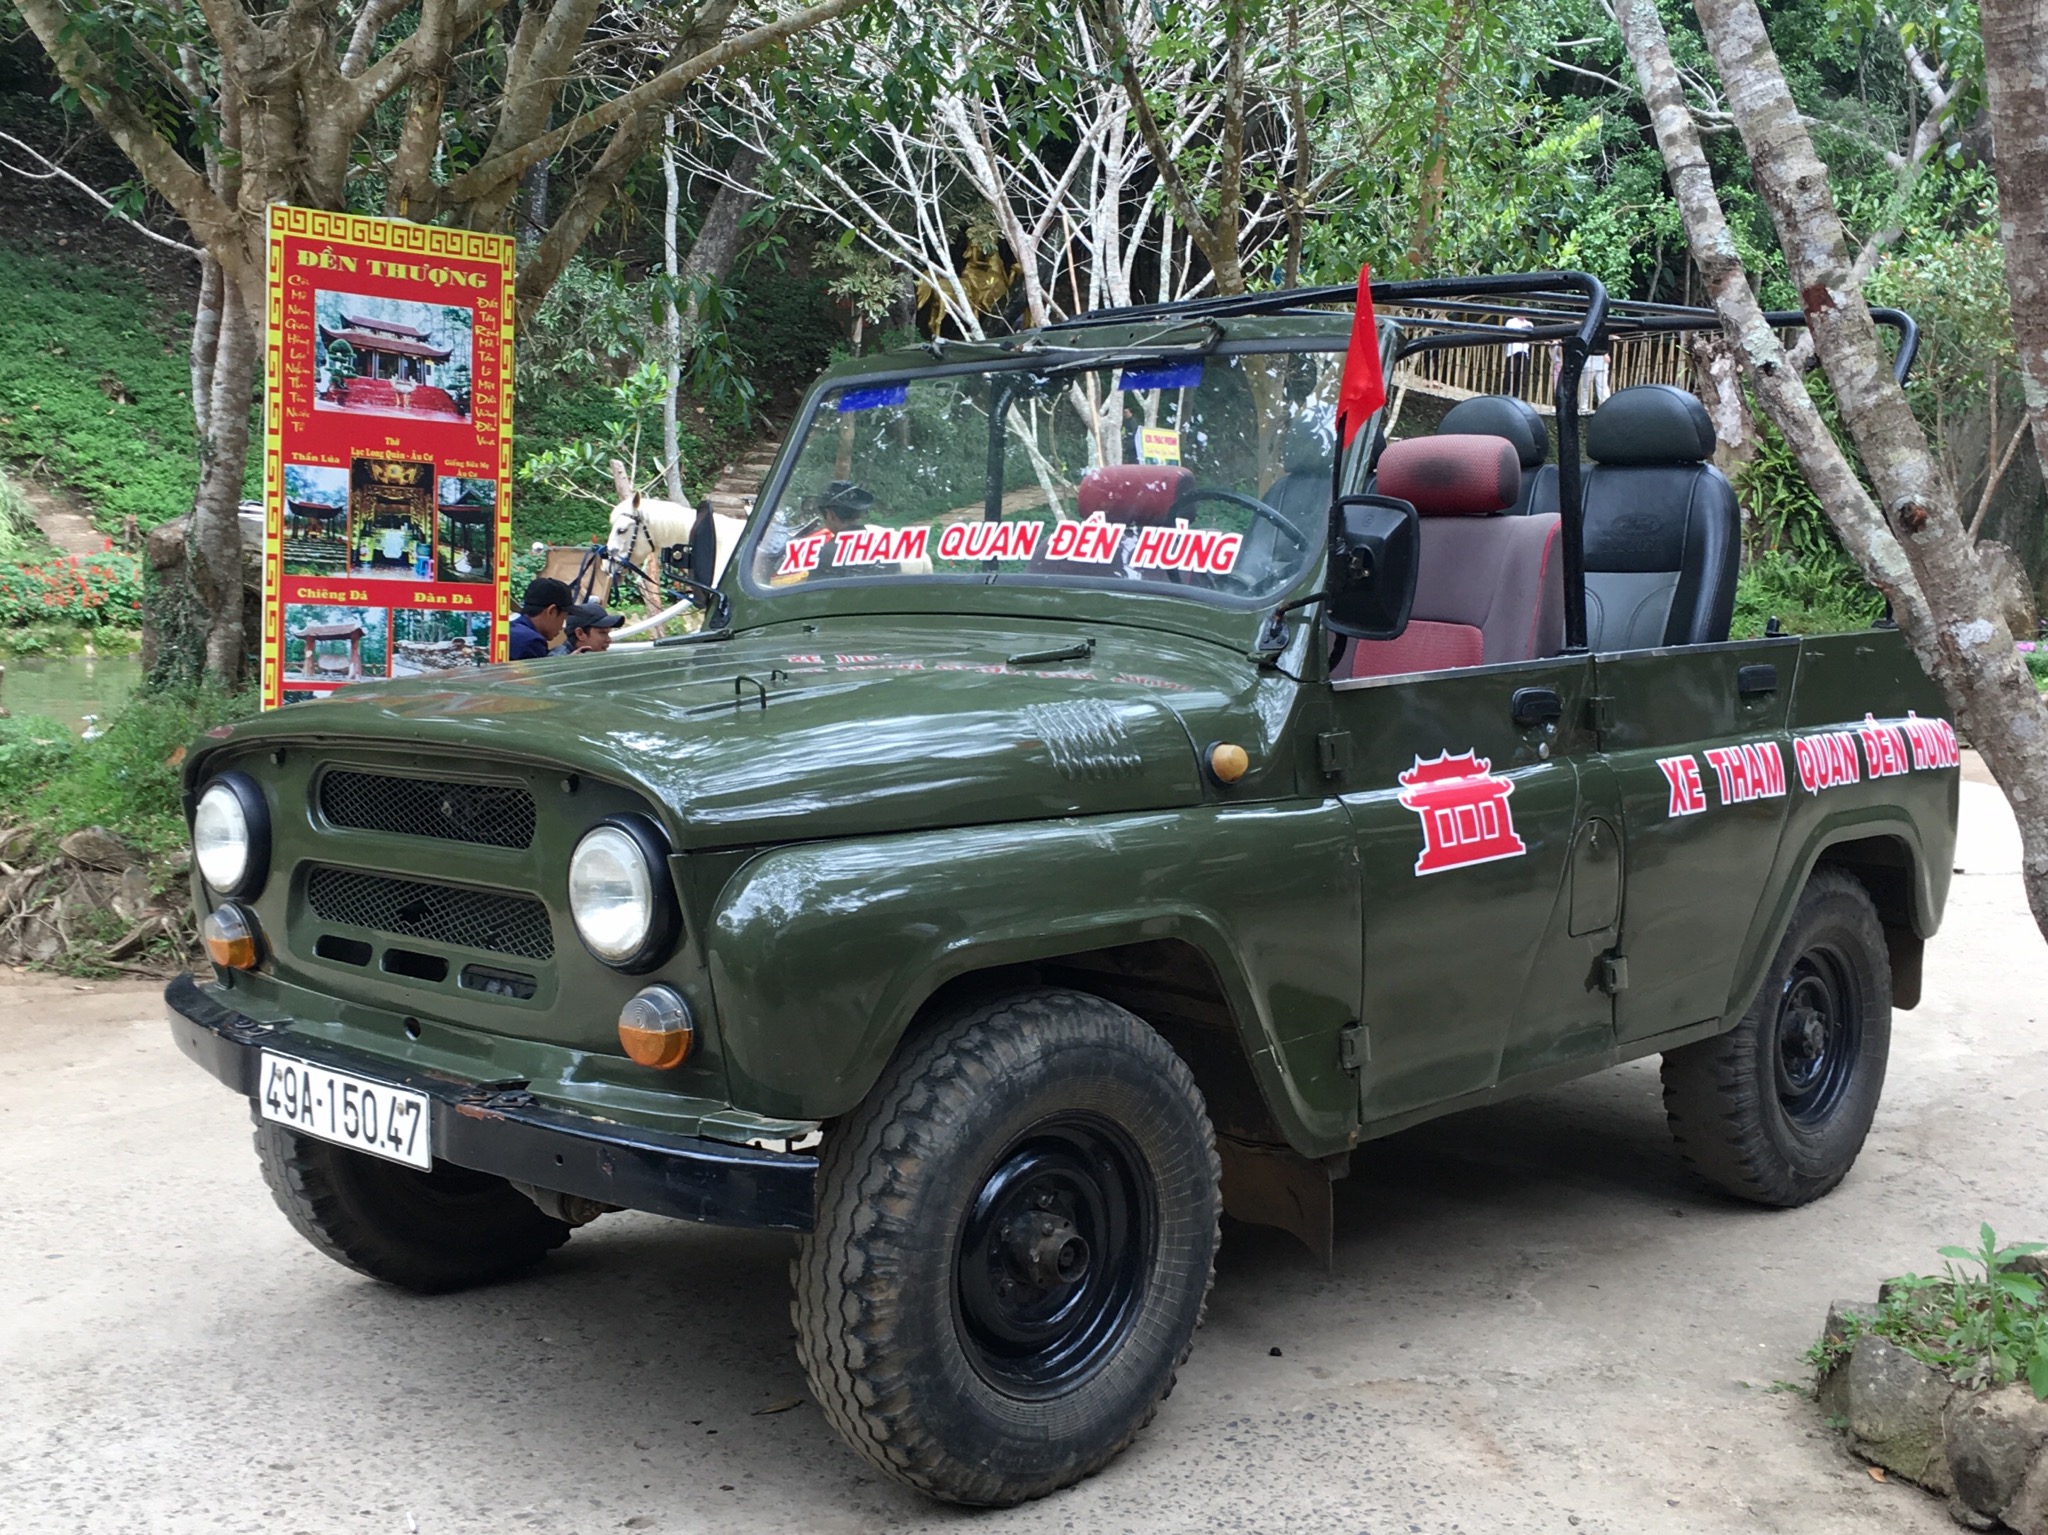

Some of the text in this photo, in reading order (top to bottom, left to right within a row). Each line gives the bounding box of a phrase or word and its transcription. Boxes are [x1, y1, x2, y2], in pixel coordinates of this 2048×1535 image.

[297, 245, 488, 289] ĐỀN THƯỢNG
[781, 513, 1243, 575] XE THAM QUAN ĐỀN HÙNG
[297, 587, 368, 602] Chiêng Đá
[413, 591, 473, 605] Đàn Đá
[1656, 755, 1707, 817] XE
[1705, 742, 1786, 805] THAM
[1794, 731, 1860, 796] QUAN
[1905, 709, 1960, 770] HÙNG
[266, 1061, 422, 1156] 49A-150.47
